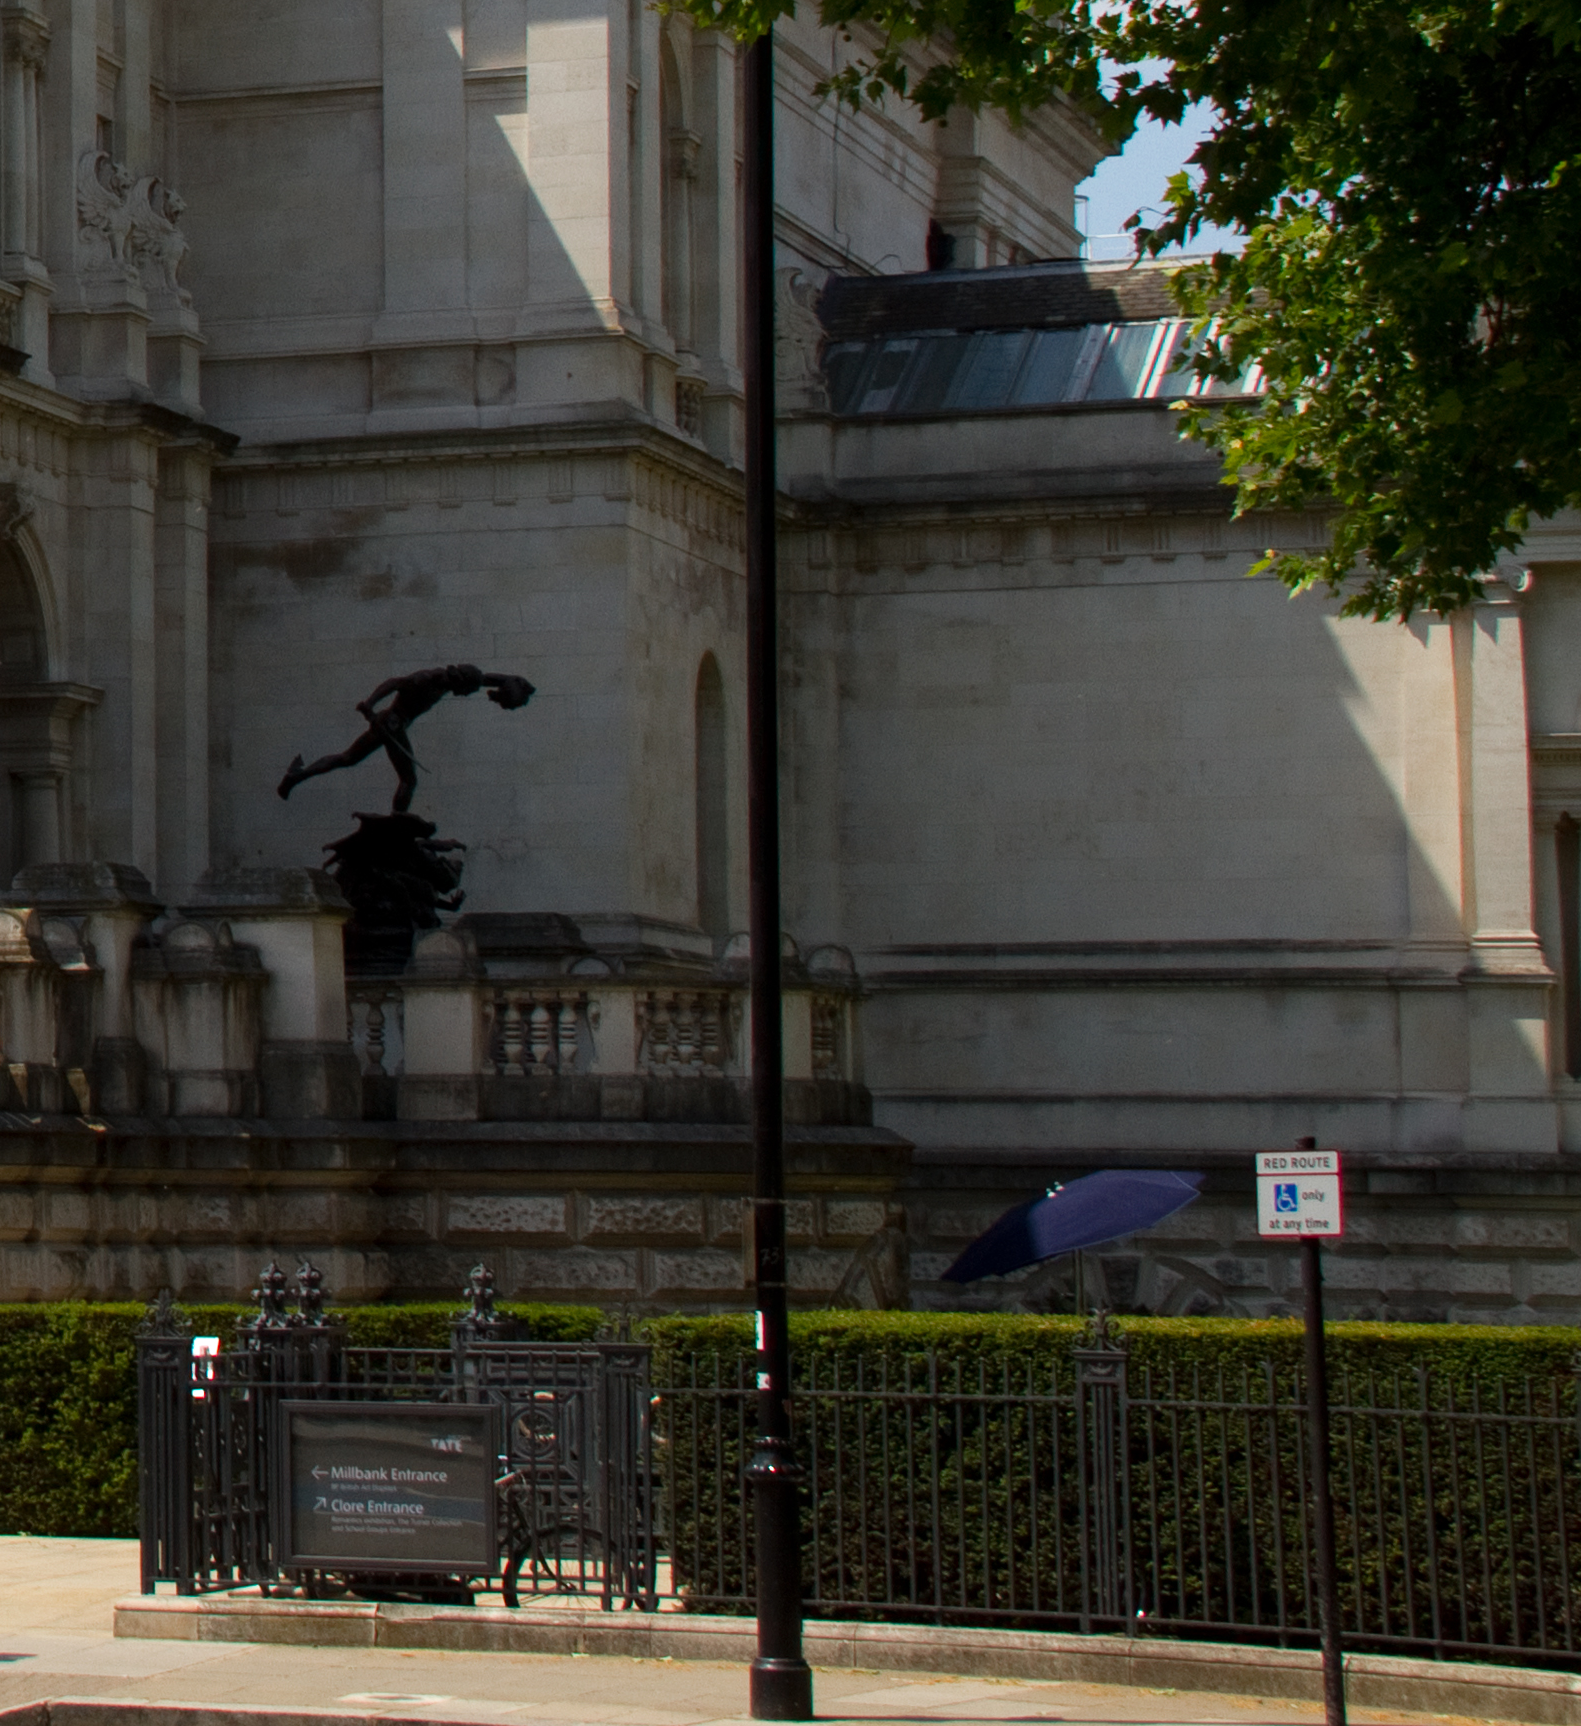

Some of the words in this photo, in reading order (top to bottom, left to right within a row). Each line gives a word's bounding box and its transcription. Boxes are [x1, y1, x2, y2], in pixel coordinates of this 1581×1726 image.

[1264, 1158, 1286, 1168] RED
[1291, 1157, 1330, 1168] ROUTE
[1302, 1190, 1325, 1202] only
[1269, 1219, 1279, 1229] at
[1283, 1220, 1302, 1231] any
[1305, 1218, 1329, 1228] time
[431, 1439, 463, 1452] TATE
[331, 1466, 387, 1480] Millbank
[391, 1468, 447, 1482] Entrance
[332, 1499, 364, 1512] Clore
[368, 1500, 424, 1514] Entrance
